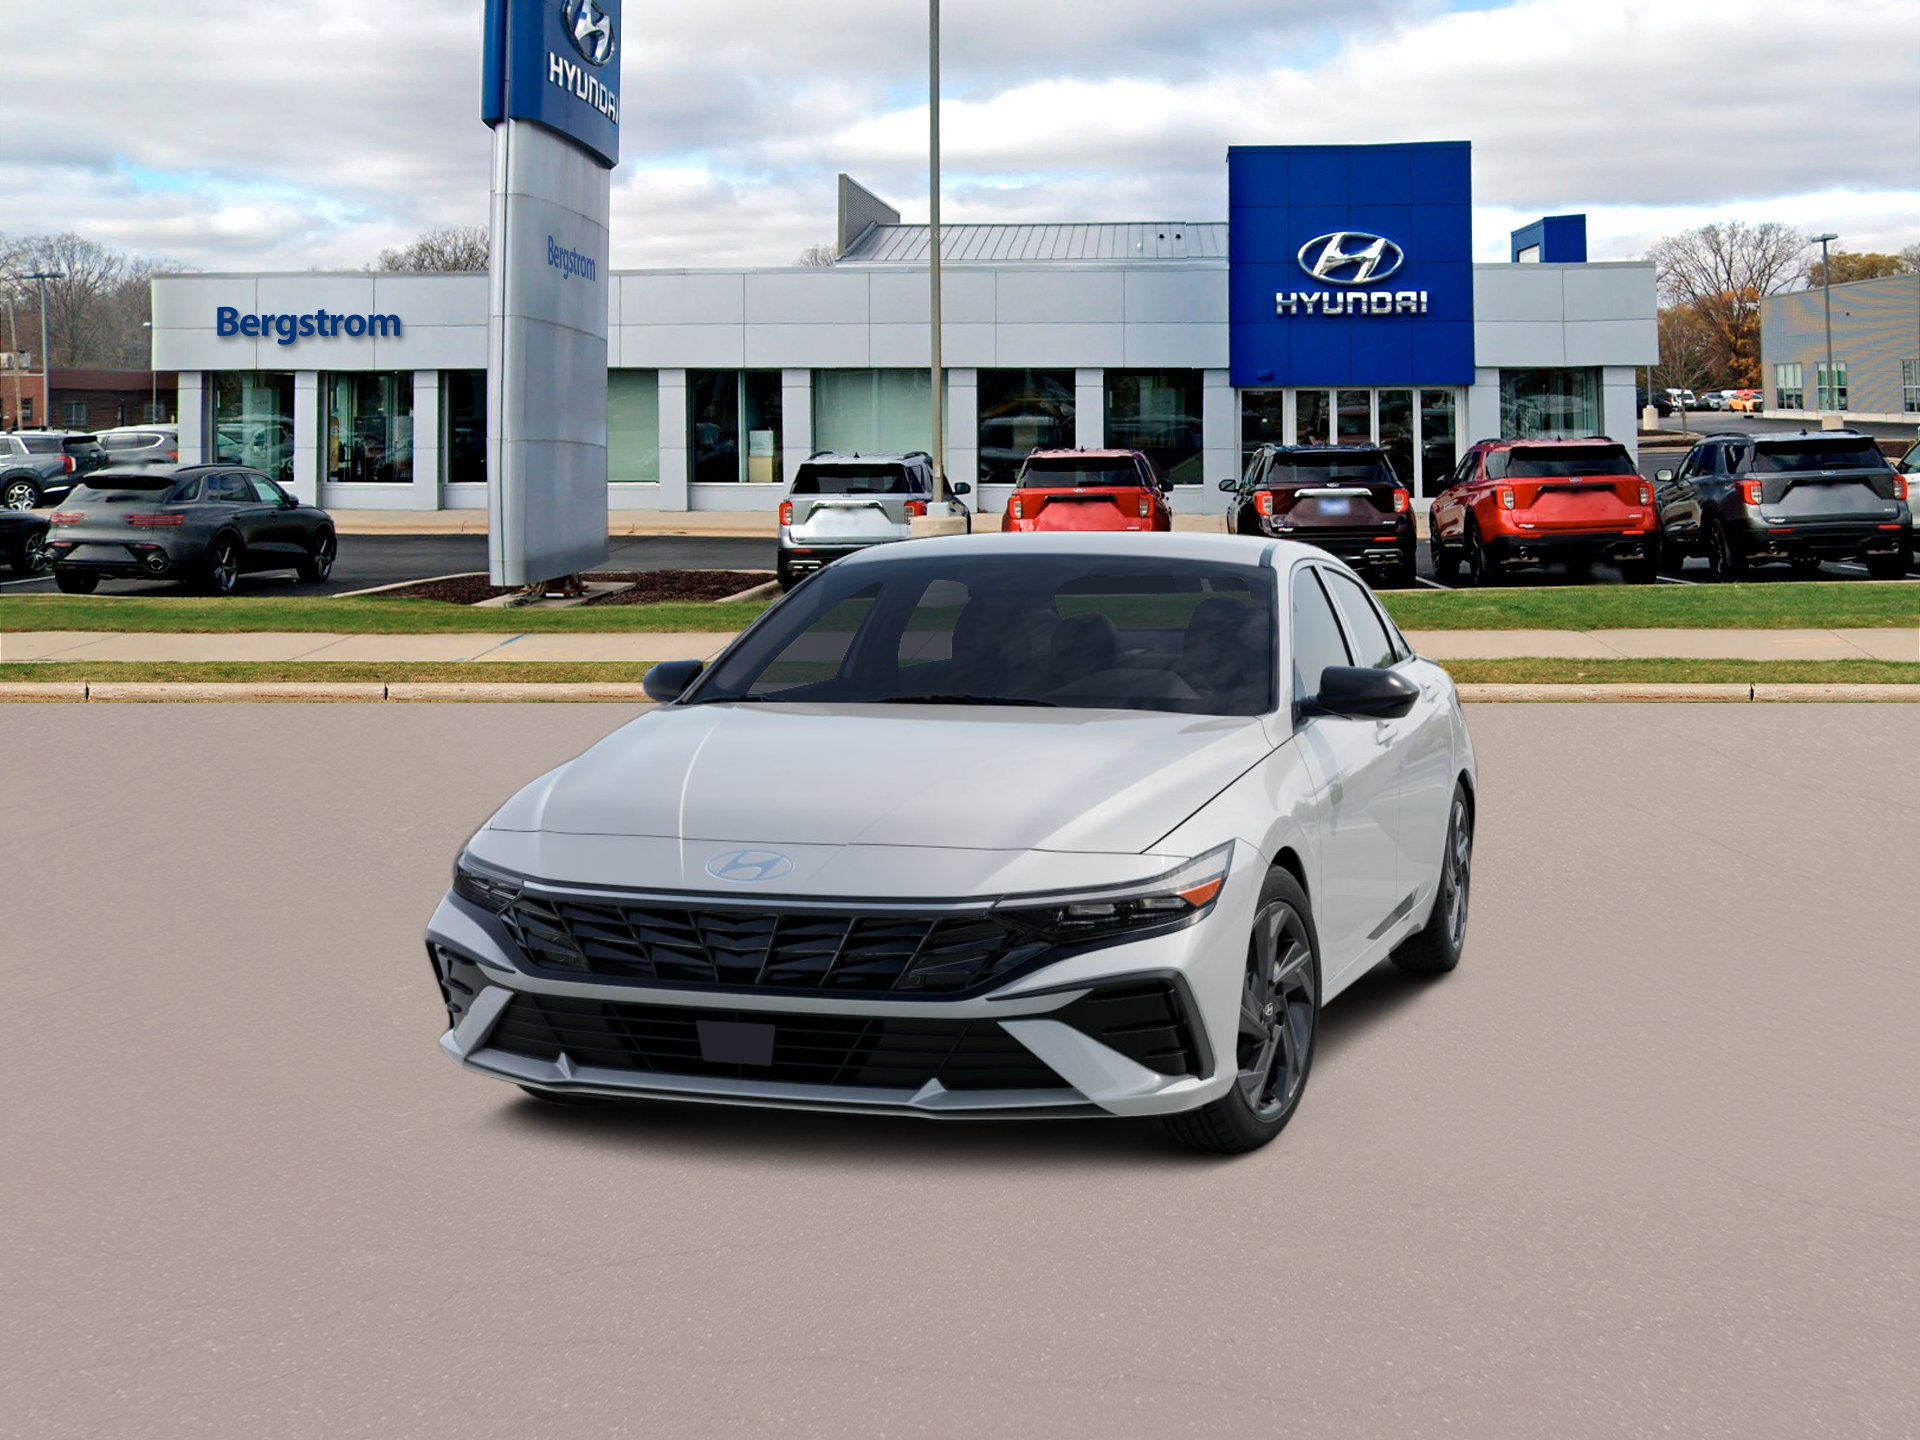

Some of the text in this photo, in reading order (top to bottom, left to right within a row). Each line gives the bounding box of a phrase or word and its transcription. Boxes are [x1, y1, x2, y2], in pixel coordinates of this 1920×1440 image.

[549, 52, 619, 124] HYUNDAI
[547, 235, 596, 282] Bergstrom
[1275, 291, 1428, 315] HYUNDAI
[217, 306, 401, 346] Bergstrom
